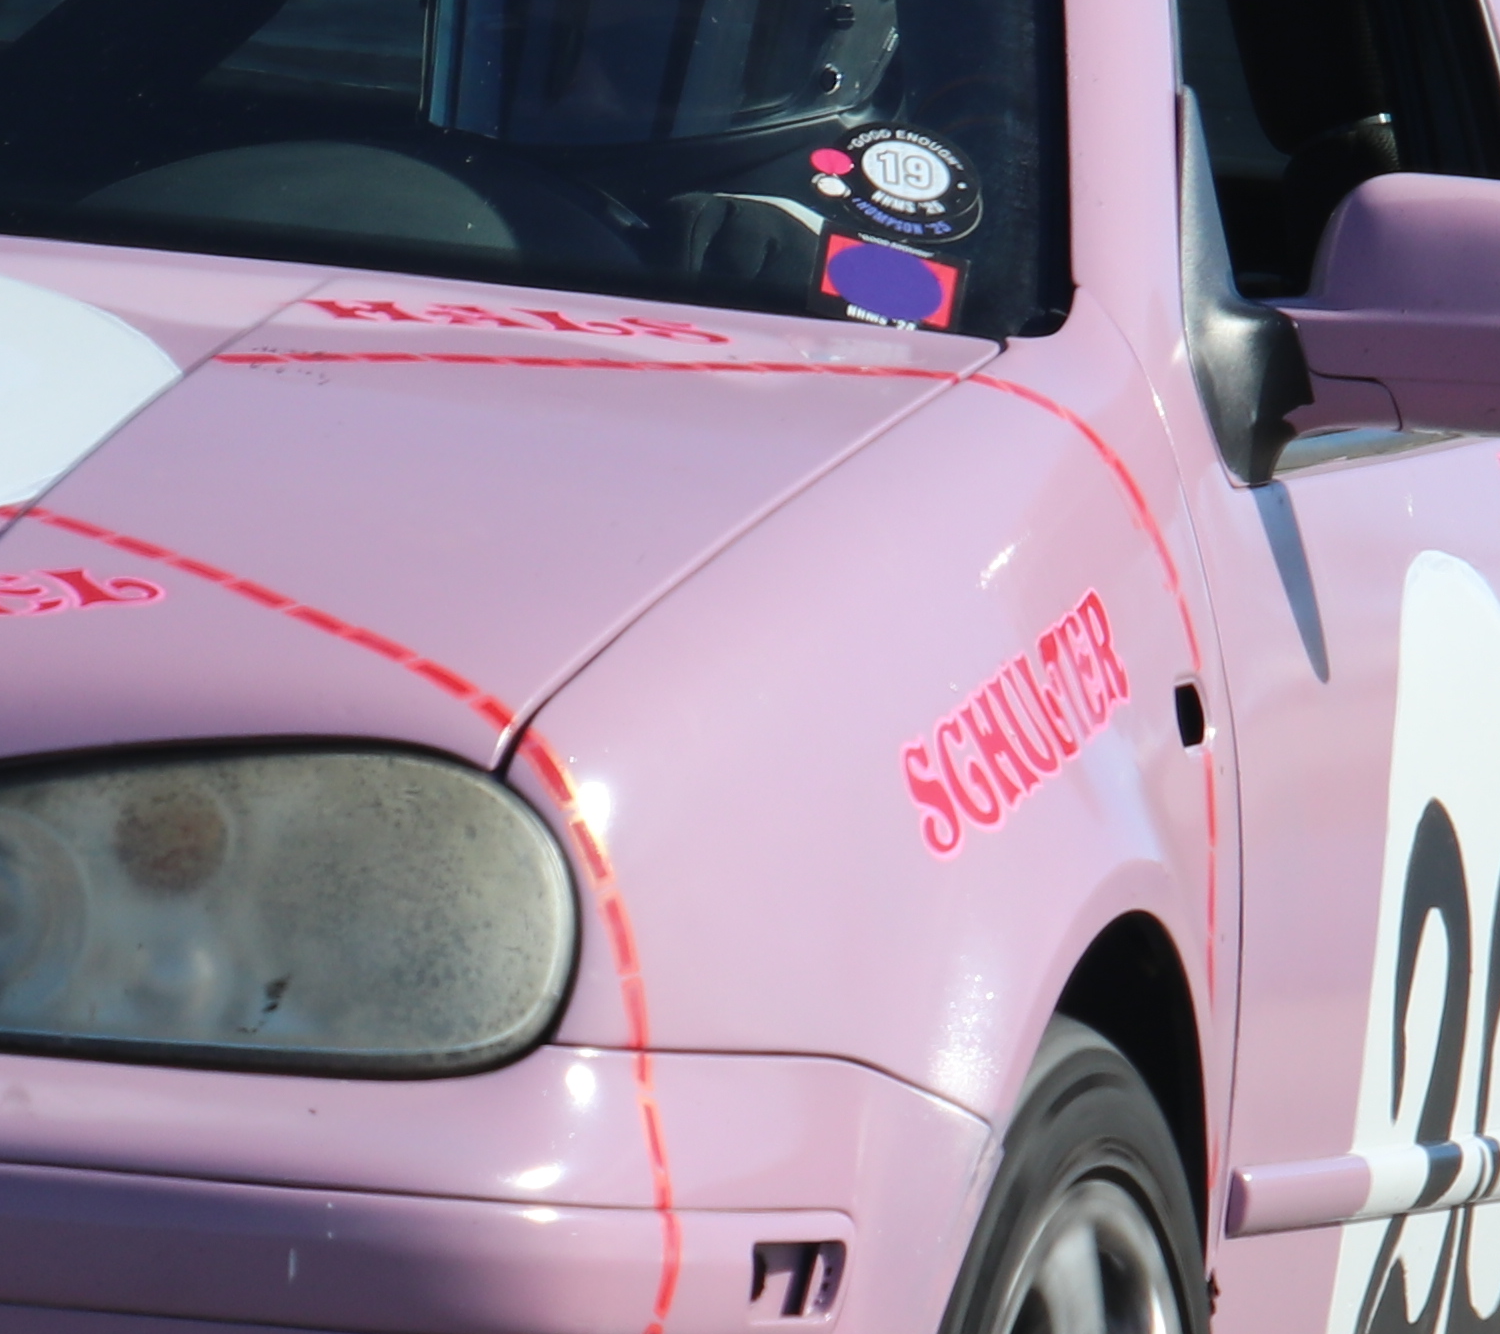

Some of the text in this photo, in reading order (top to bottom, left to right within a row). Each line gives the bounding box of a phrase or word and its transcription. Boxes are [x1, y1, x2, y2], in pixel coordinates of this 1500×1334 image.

[876, 149, 933, 190] 19
[299, 299, 731, 347] HALS
[901, 587, 1131, 861] SCHULTER
